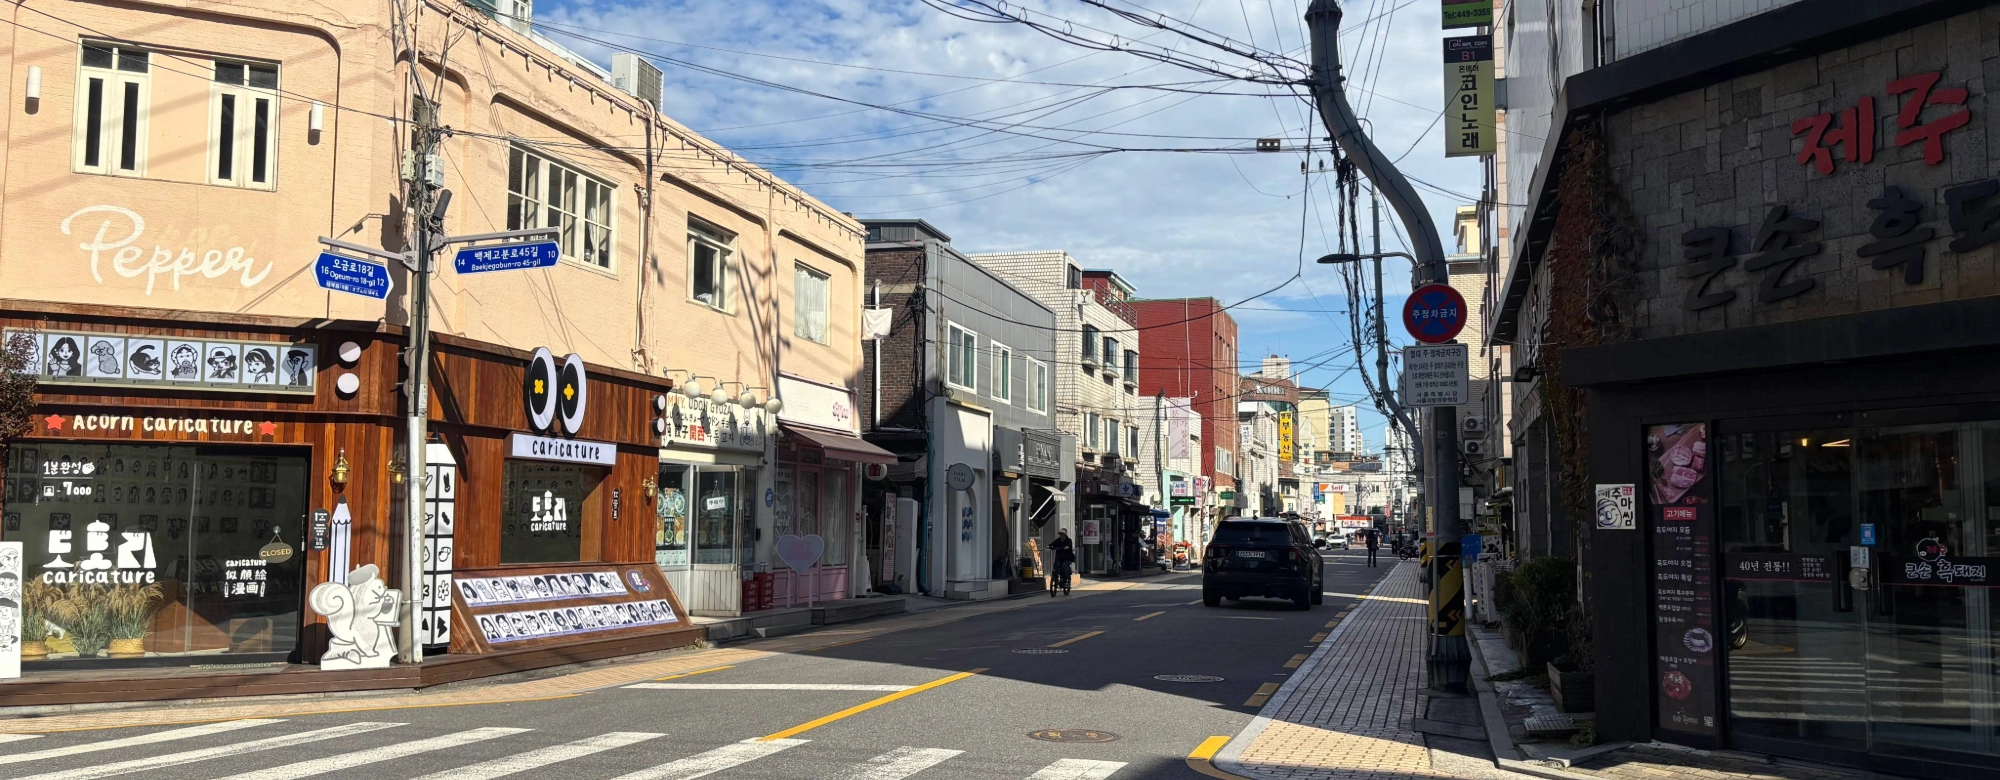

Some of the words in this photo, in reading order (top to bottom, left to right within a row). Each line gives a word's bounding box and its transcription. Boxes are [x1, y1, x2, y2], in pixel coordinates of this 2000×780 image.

[1443, 8, 1491, 19] Tel:449-3355
[1462, 51, 1475, 60] B1
[1460, 74, 1479, 149] 코인노래
[1791, 71, 1971, 175] 제주
[60, 204, 273, 295] Pepper
[474, 246, 539, 261] 백제고분로45길
[472, 261, 522, 271] Baekjegobun-ro
[522, 258, 540, 268] 45-gil
[548, 250, 556, 258] 10
[1677, 204, 1822, 312] 큰손
[332, 259, 374, 278] 오금로18길
[321, 266, 330, 274] 16
[330, 270, 360, 283] Ogeum-ro
[360, 277, 376, 288] 18-gil
[377, 278, 384, 286] 12
[1412, 307, 1458, 320] 주정차금지
[689, 398, 708, 411] UDON
[72, 413, 134, 432] Acorn
[143, 416, 254, 436] caricature
[1282, 421, 1291, 454] 부동산
[532, 439, 600, 460] caricature
[43, 460, 82, 476] 1분완성
[62, 482, 92, 496] 7000
[1666, 510, 1693, 518] 고기메뉴
[530, 521, 567, 532] caricature
[260, 548, 292, 557] CLOSED
[226, 558, 267, 567] caricature
[1739, 560, 1759, 572] 40년
[1763, 560, 1790, 572] 전통!!
[43, 569, 155, 584] caricature
[226, 569, 267, 580] 似顔絵
[1905, 562, 1932, 579] 큰손
[1936, 559, 1986, 583] 흑돼지
[231, 582, 258, 595] 漫画
